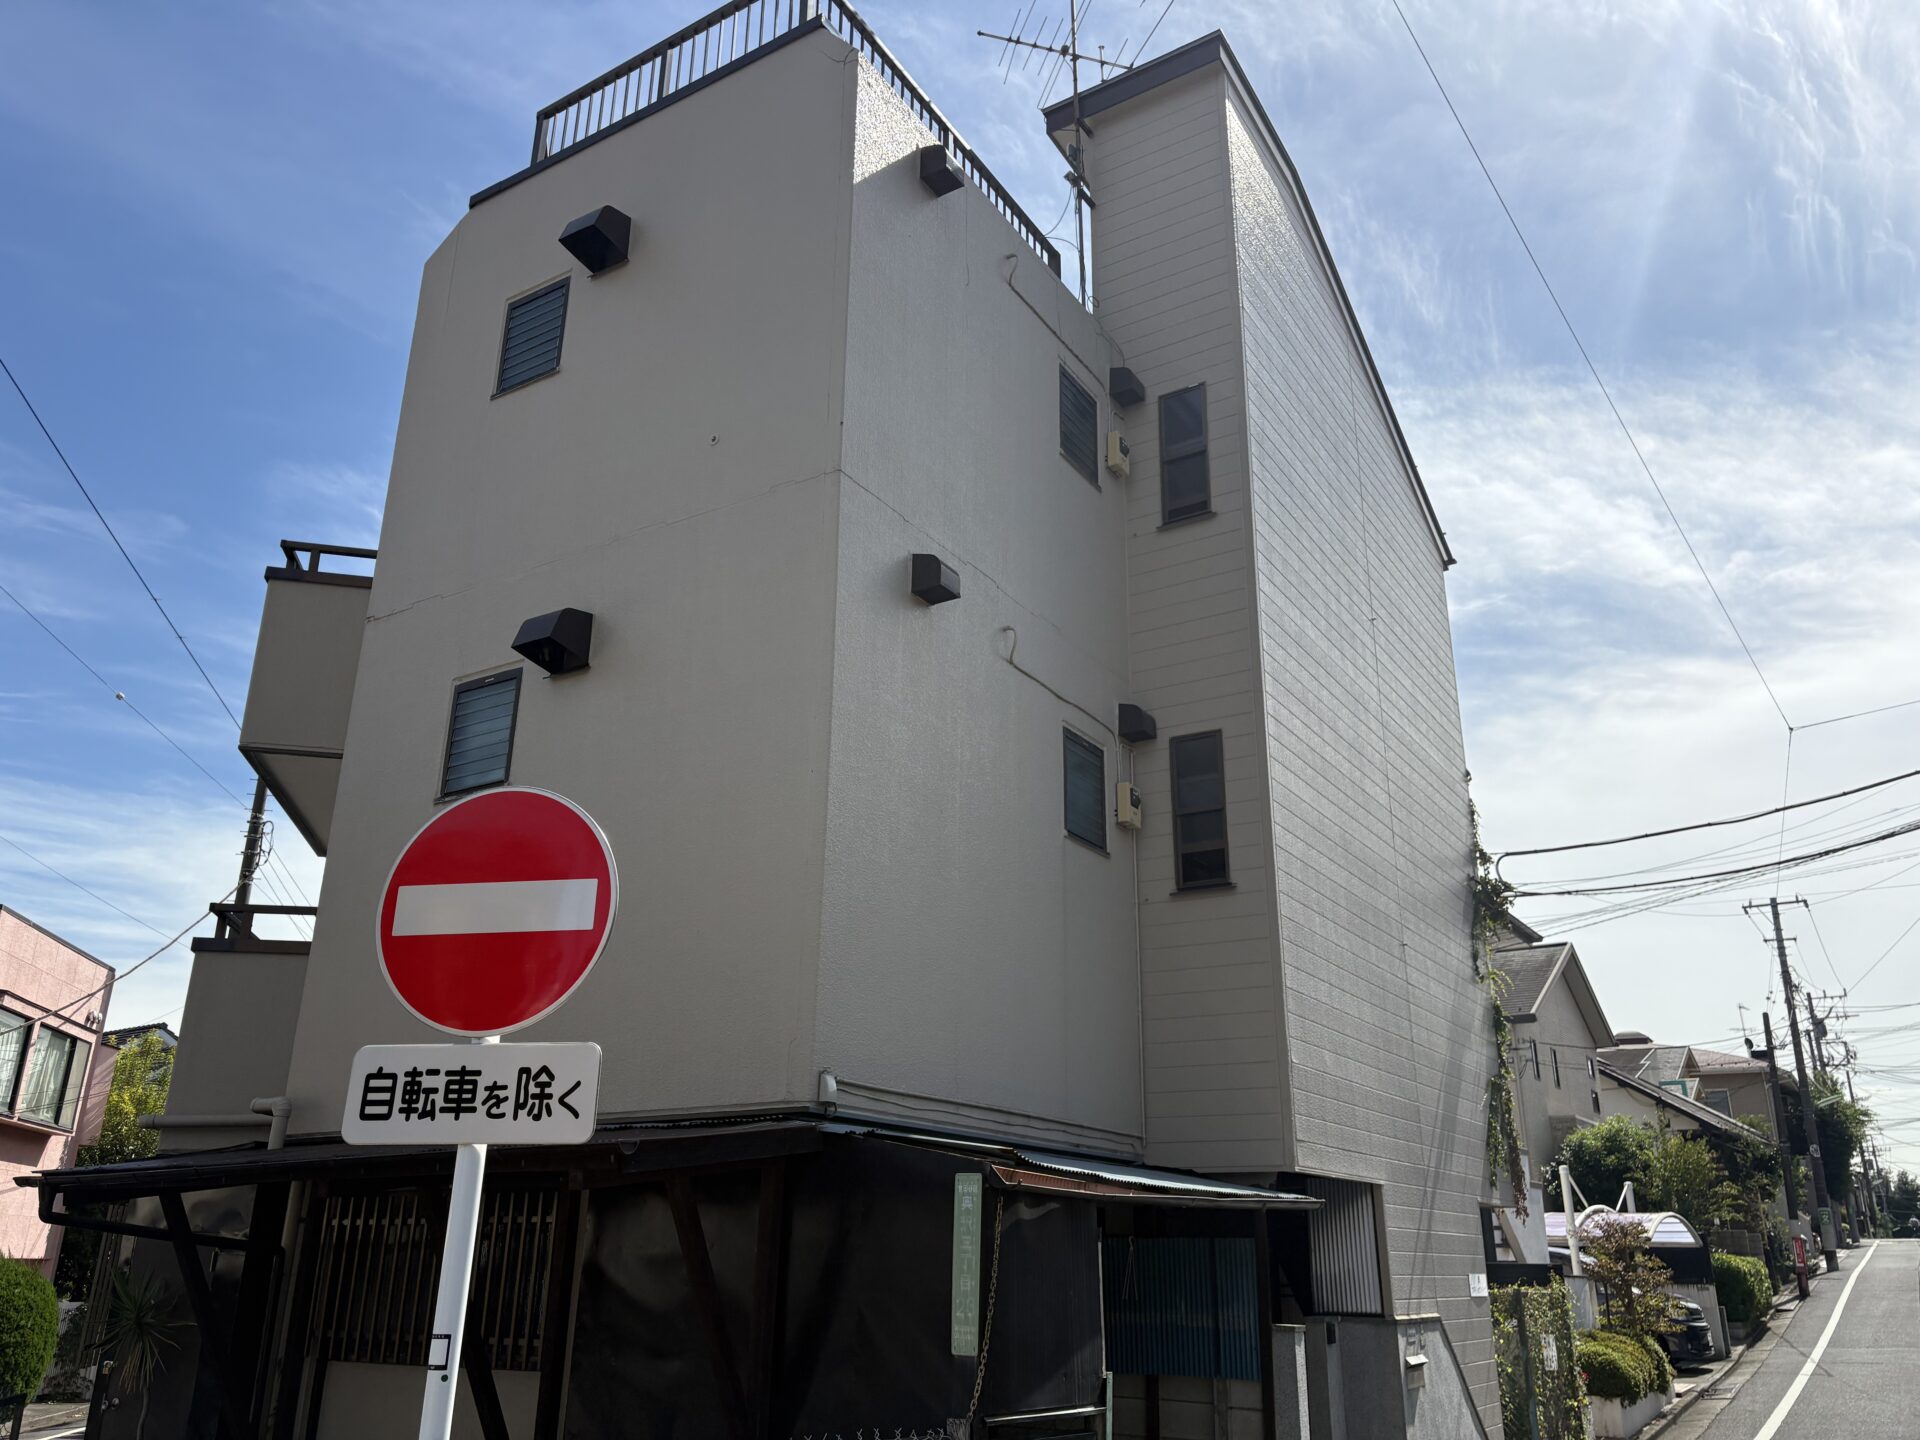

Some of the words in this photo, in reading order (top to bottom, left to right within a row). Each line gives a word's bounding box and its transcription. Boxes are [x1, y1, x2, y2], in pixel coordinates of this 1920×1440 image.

[359, 1065, 581, 1122] 自転車を除く
